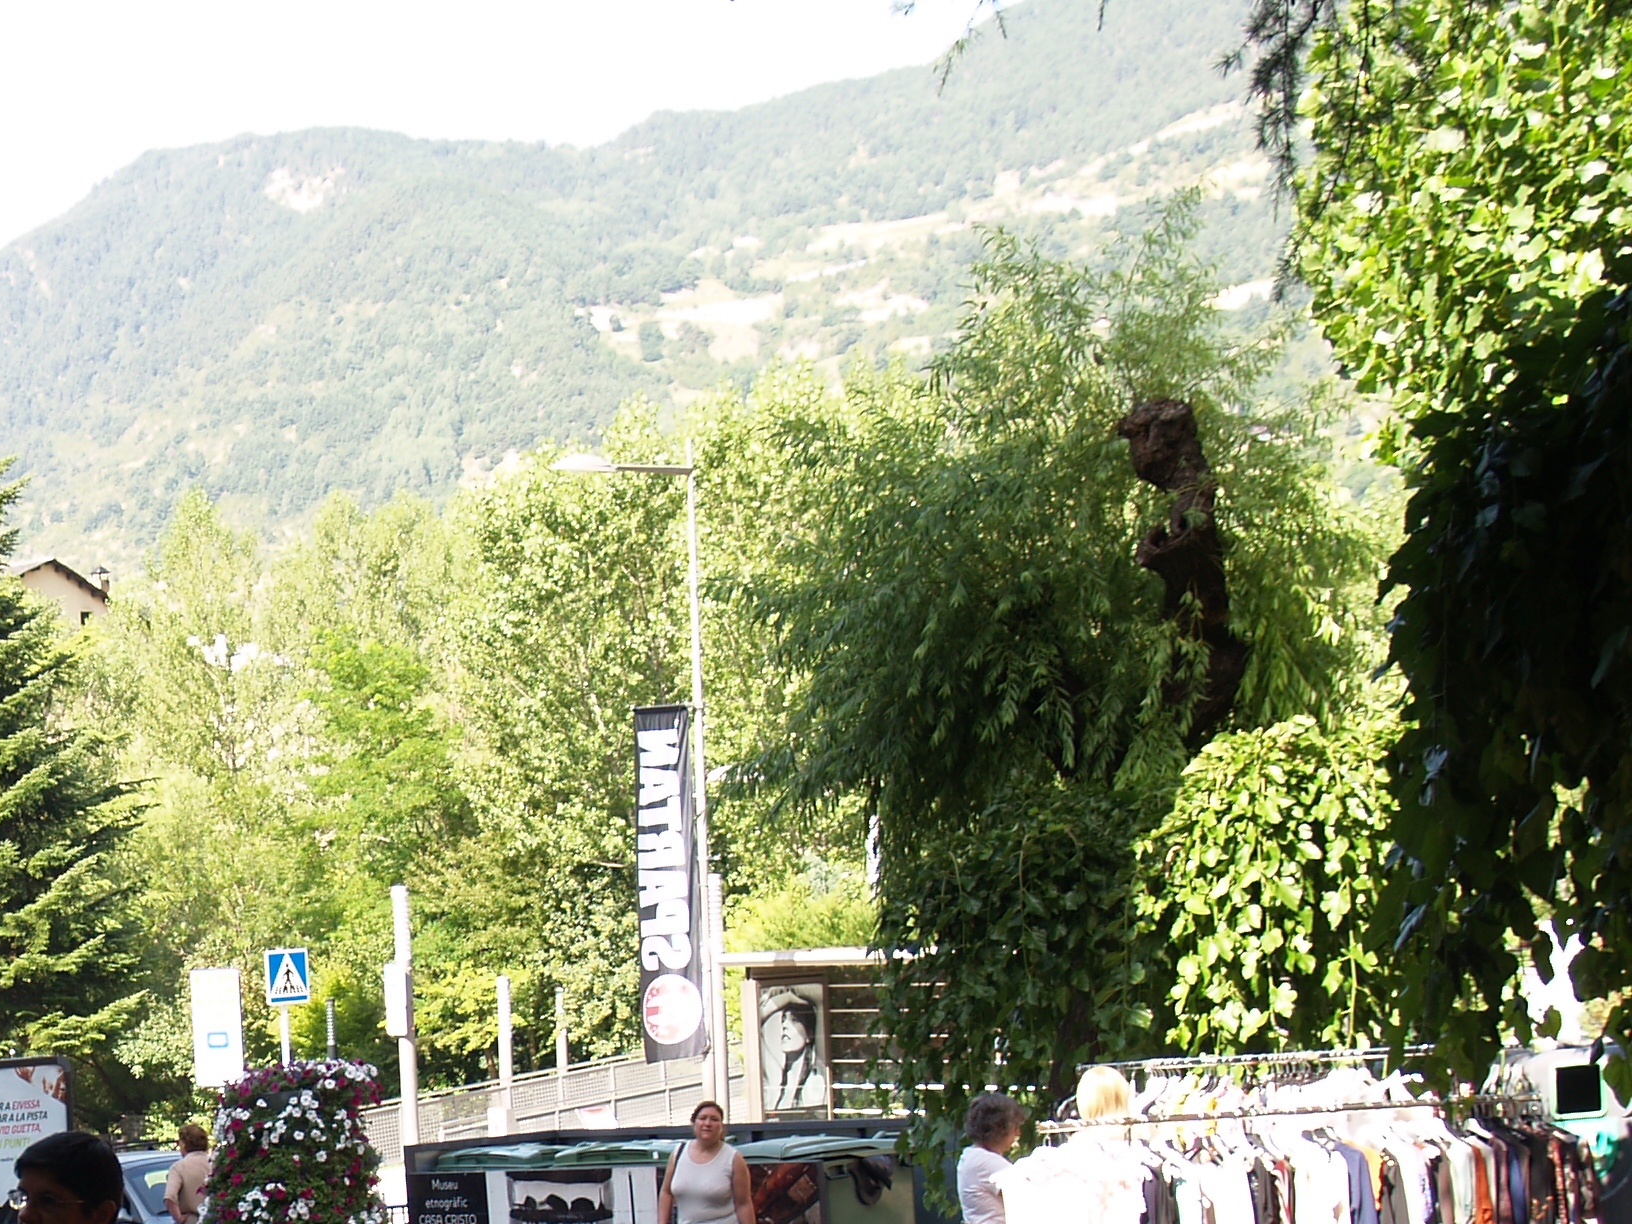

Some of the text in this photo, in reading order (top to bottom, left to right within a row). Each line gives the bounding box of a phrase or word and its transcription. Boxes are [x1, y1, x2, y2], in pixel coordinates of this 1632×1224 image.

[4, 1102, 11, 1110] A
[12, 1100, 41, 1110] EIVISSA
[8, 1113, 14, 1122] A
[15, 1112, 25, 1121] LA
[26, 1111, 48, 1121] PISTA
[431, 1179, 459, 1191] Museu
